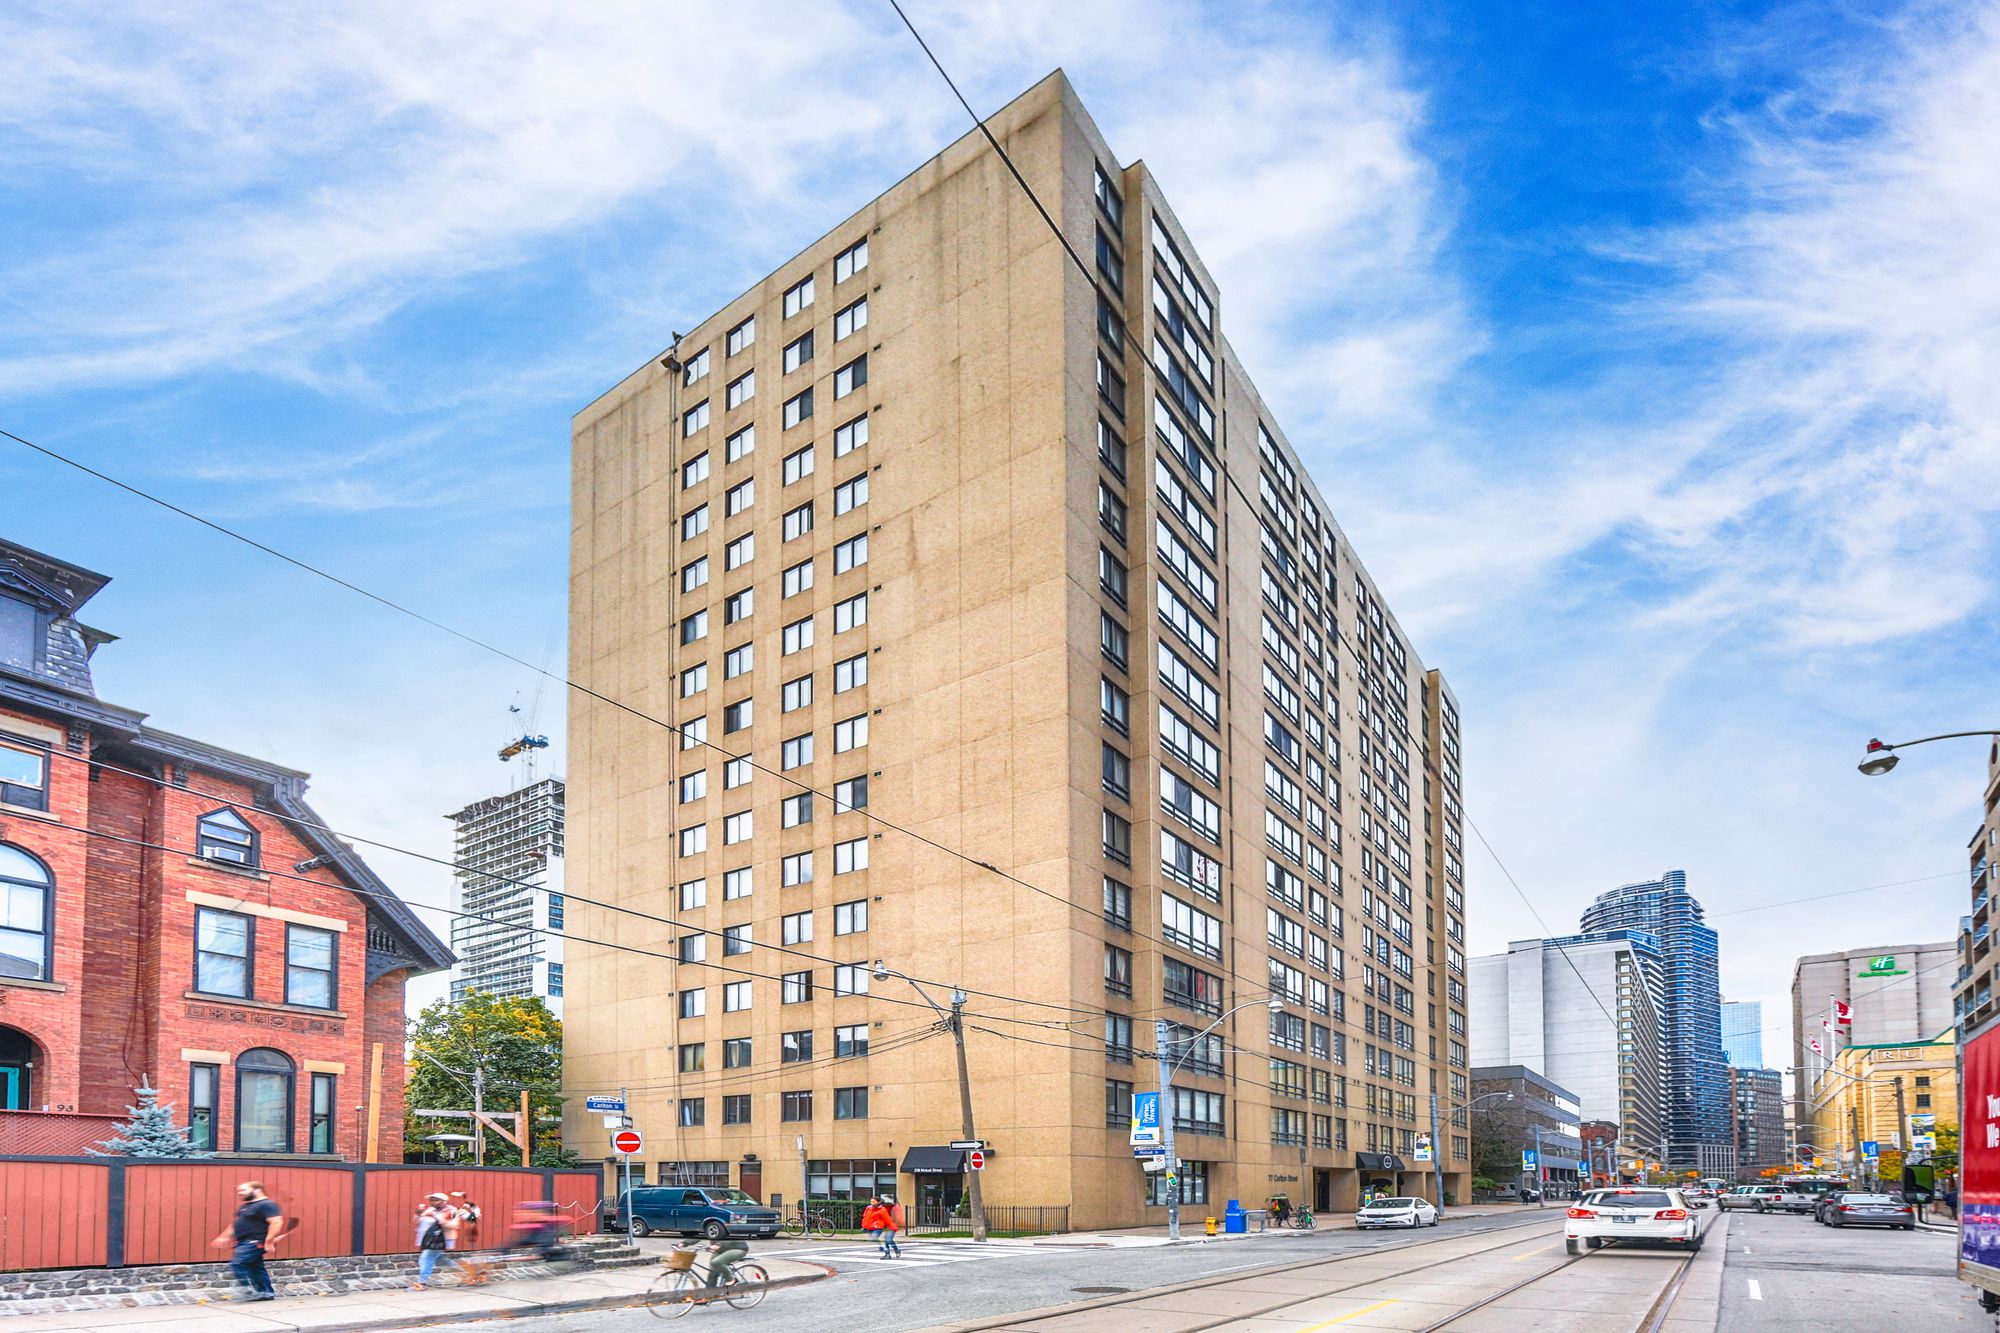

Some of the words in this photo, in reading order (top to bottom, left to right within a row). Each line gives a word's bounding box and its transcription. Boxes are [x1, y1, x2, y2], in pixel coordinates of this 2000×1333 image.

[57, 1104, 74, 1112] 93
[1142, 1103, 1150, 1124] Ryerson
[1148, 1097, 1157, 1124] University
[1986, 1122, 2000, 1148] We
[1287, 1174, 1298, 1182] Street
